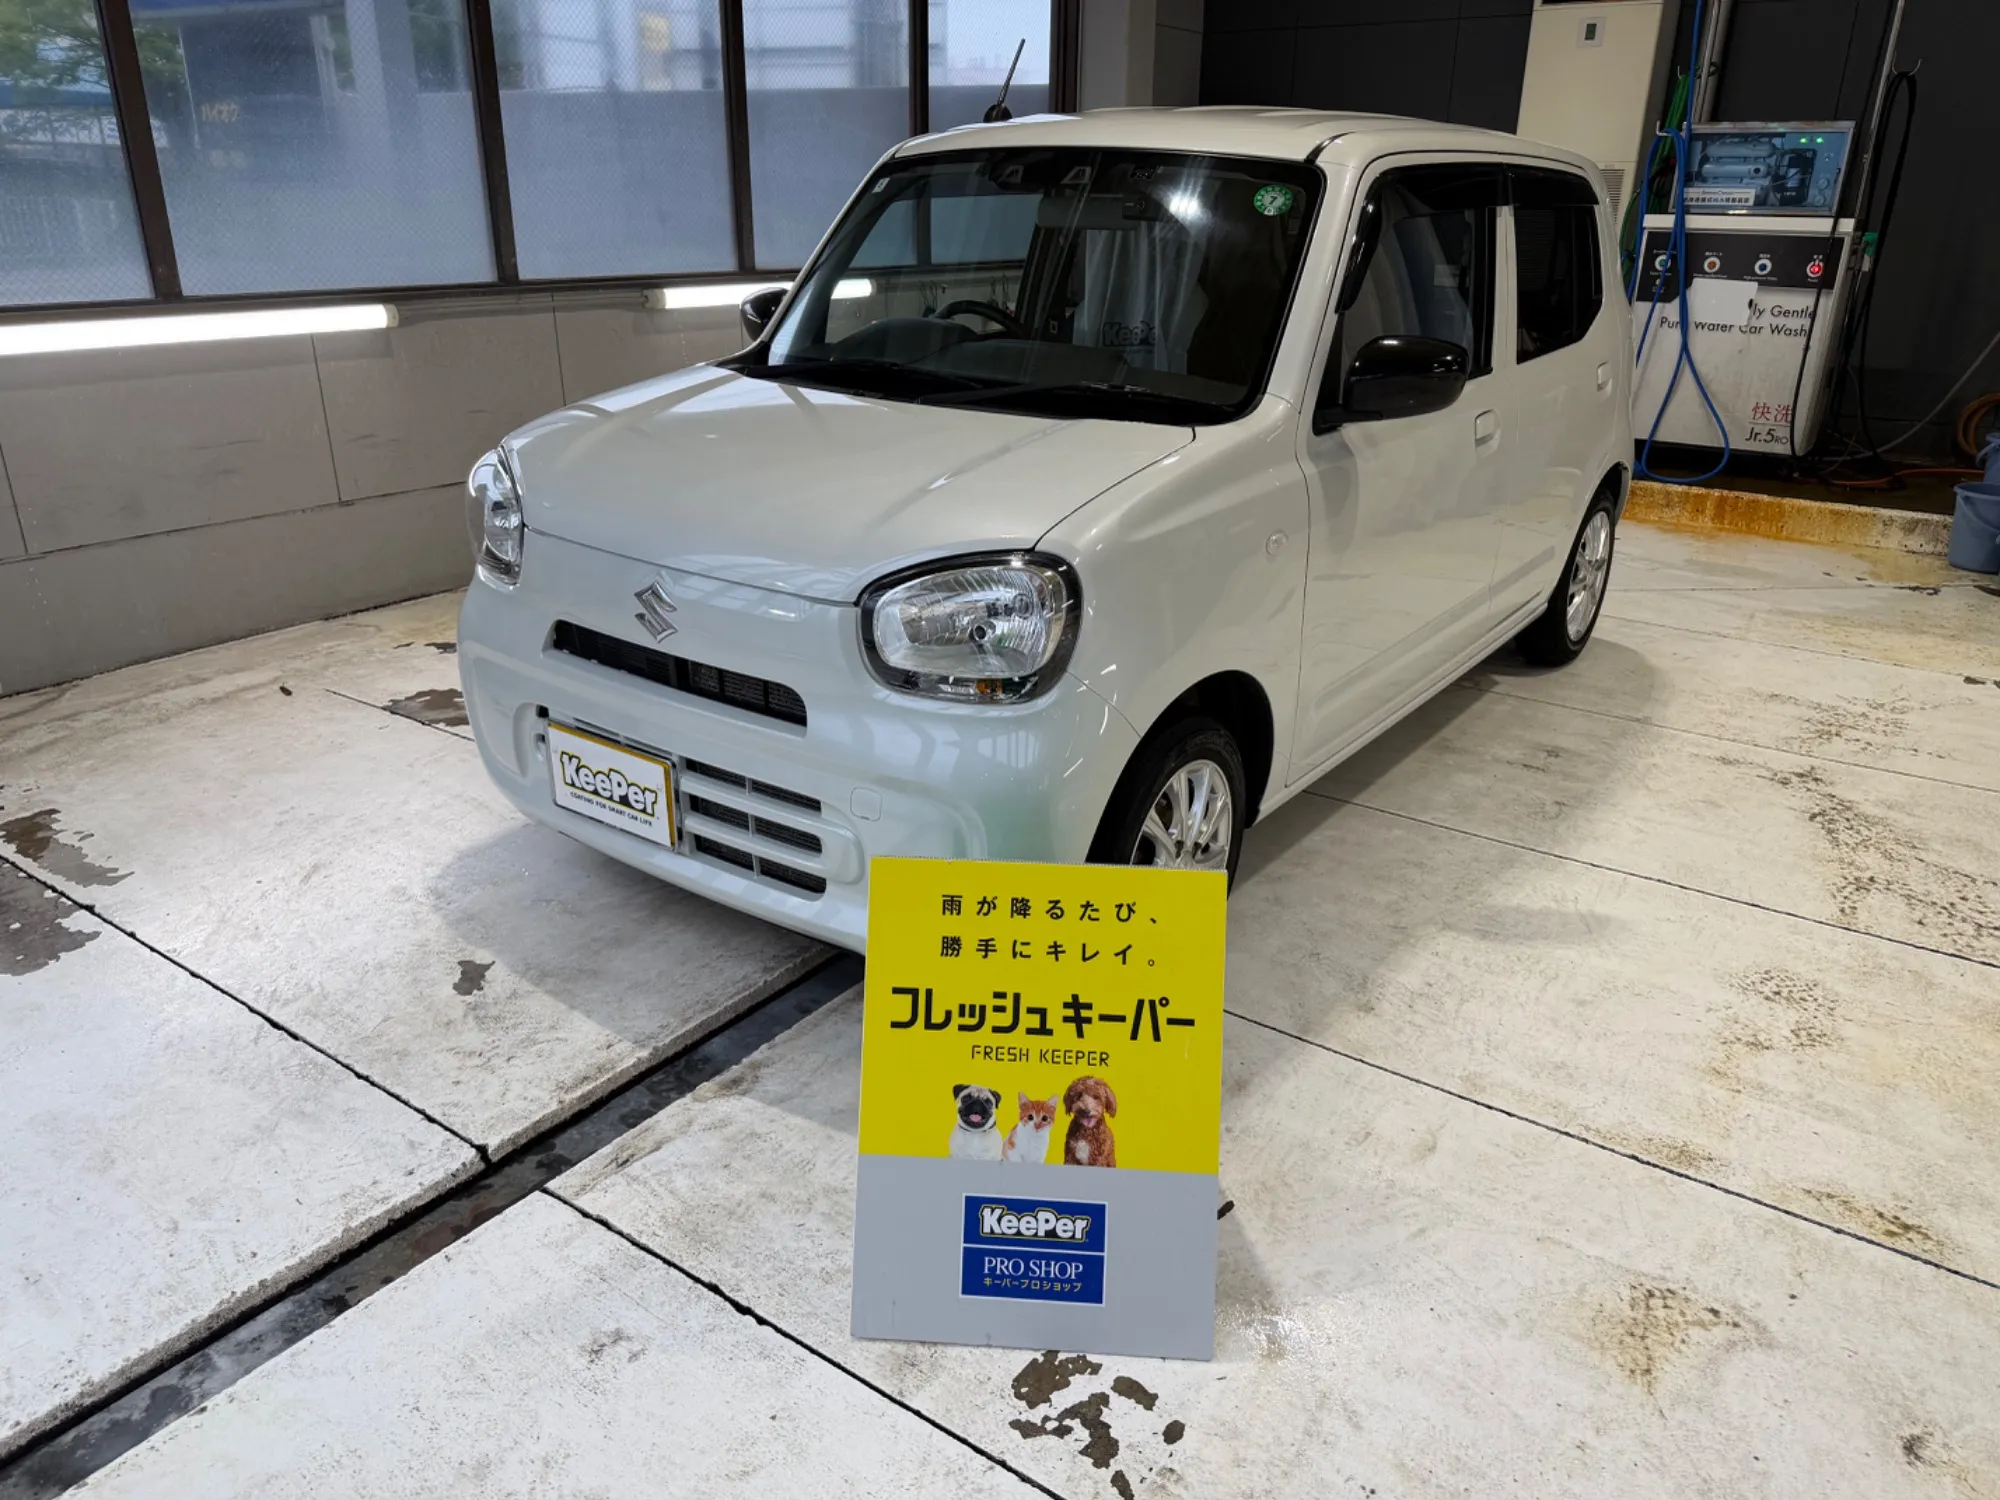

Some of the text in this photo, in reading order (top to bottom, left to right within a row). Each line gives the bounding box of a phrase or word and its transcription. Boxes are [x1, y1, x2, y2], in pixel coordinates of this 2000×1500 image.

[1659, 316, 1684, 329] Pur
[1769, 323, 1807, 338] Wash
[1770, 304, 1814, 319] Gentle
[1751, 401, 1792, 424] 快洗
[561, 752, 657, 816] KeePer
[569, 791, 595, 805] COATING
[595, 799, 607, 810] FOR
[627, 812, 639, 822] CAR
[941, 893, 1158, 925] 雨が降るたび、
[940, 935, 1156, 967] 勝手にキレイ。
[890, 986, 1196, 1042] フレッシュキーパー
[971, 1044, 1110, 1067] FRESH KEEPER
[981, 1206, 1090, 1241] KeePer
[983, 1257, 1083, 1280] PRO SHOP
